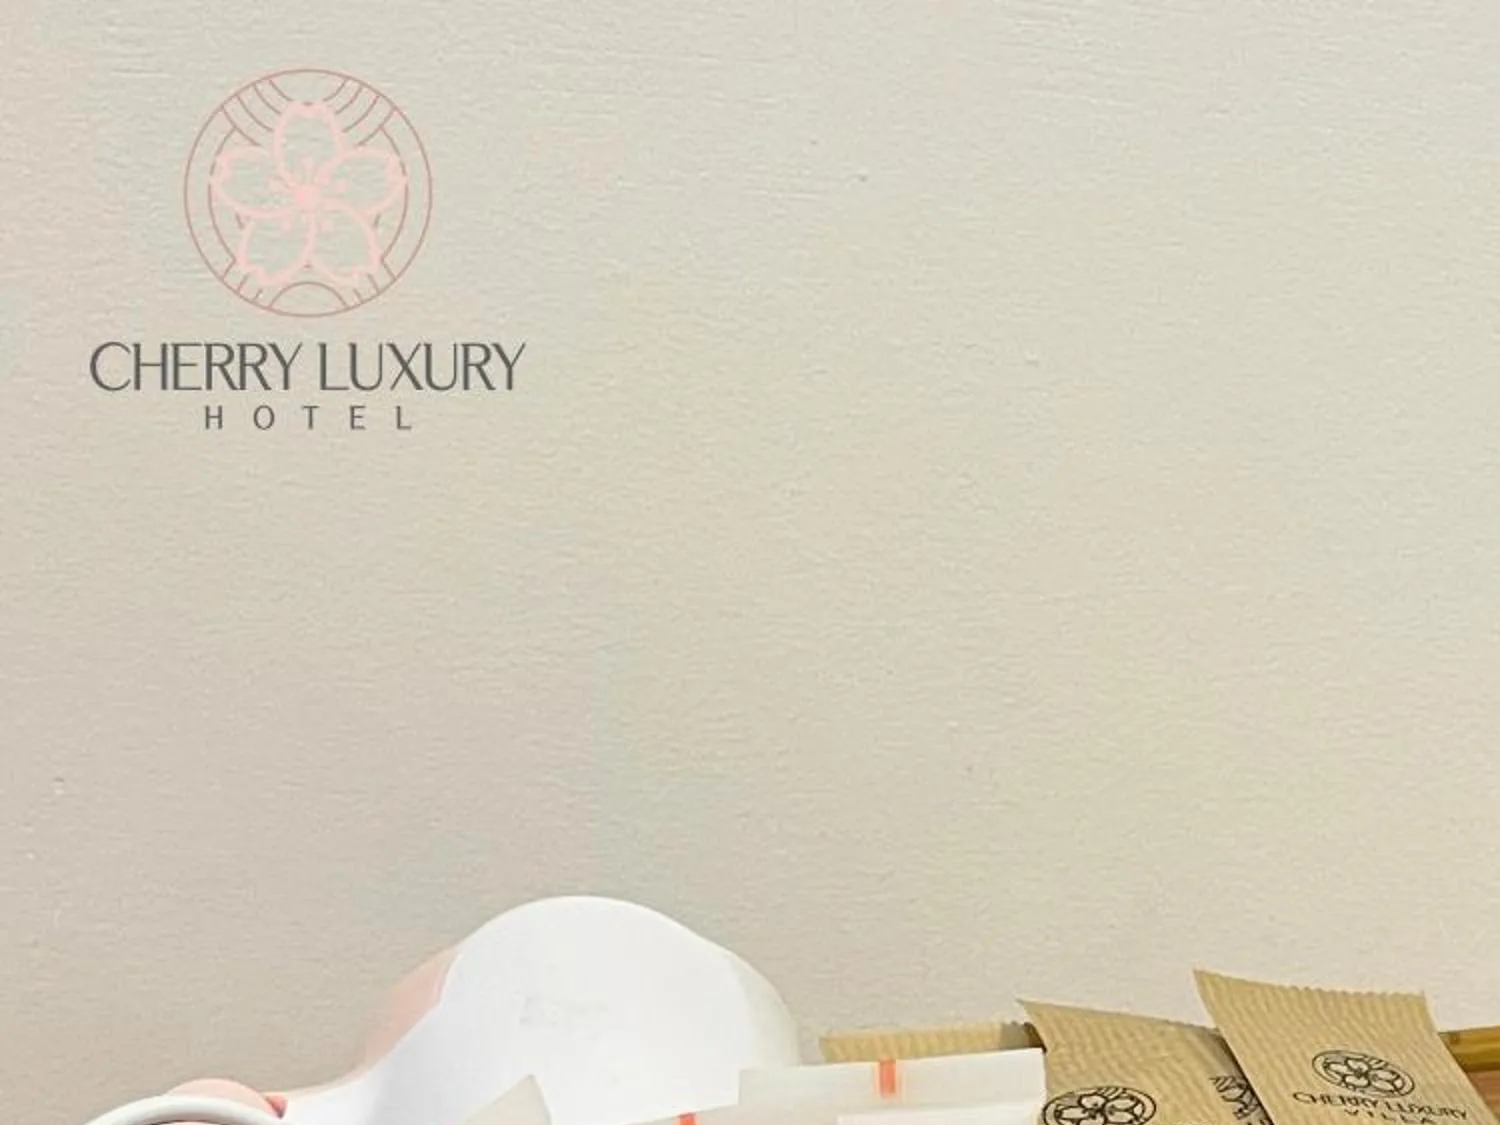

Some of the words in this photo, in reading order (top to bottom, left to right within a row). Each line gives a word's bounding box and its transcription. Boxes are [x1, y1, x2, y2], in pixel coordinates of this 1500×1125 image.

[1292, 1091, 1378, 1109] CHERRY
[1385, 1101, 1467, 1121] LUXURY
[1345, 1108, 1436, 1125] VILLA
